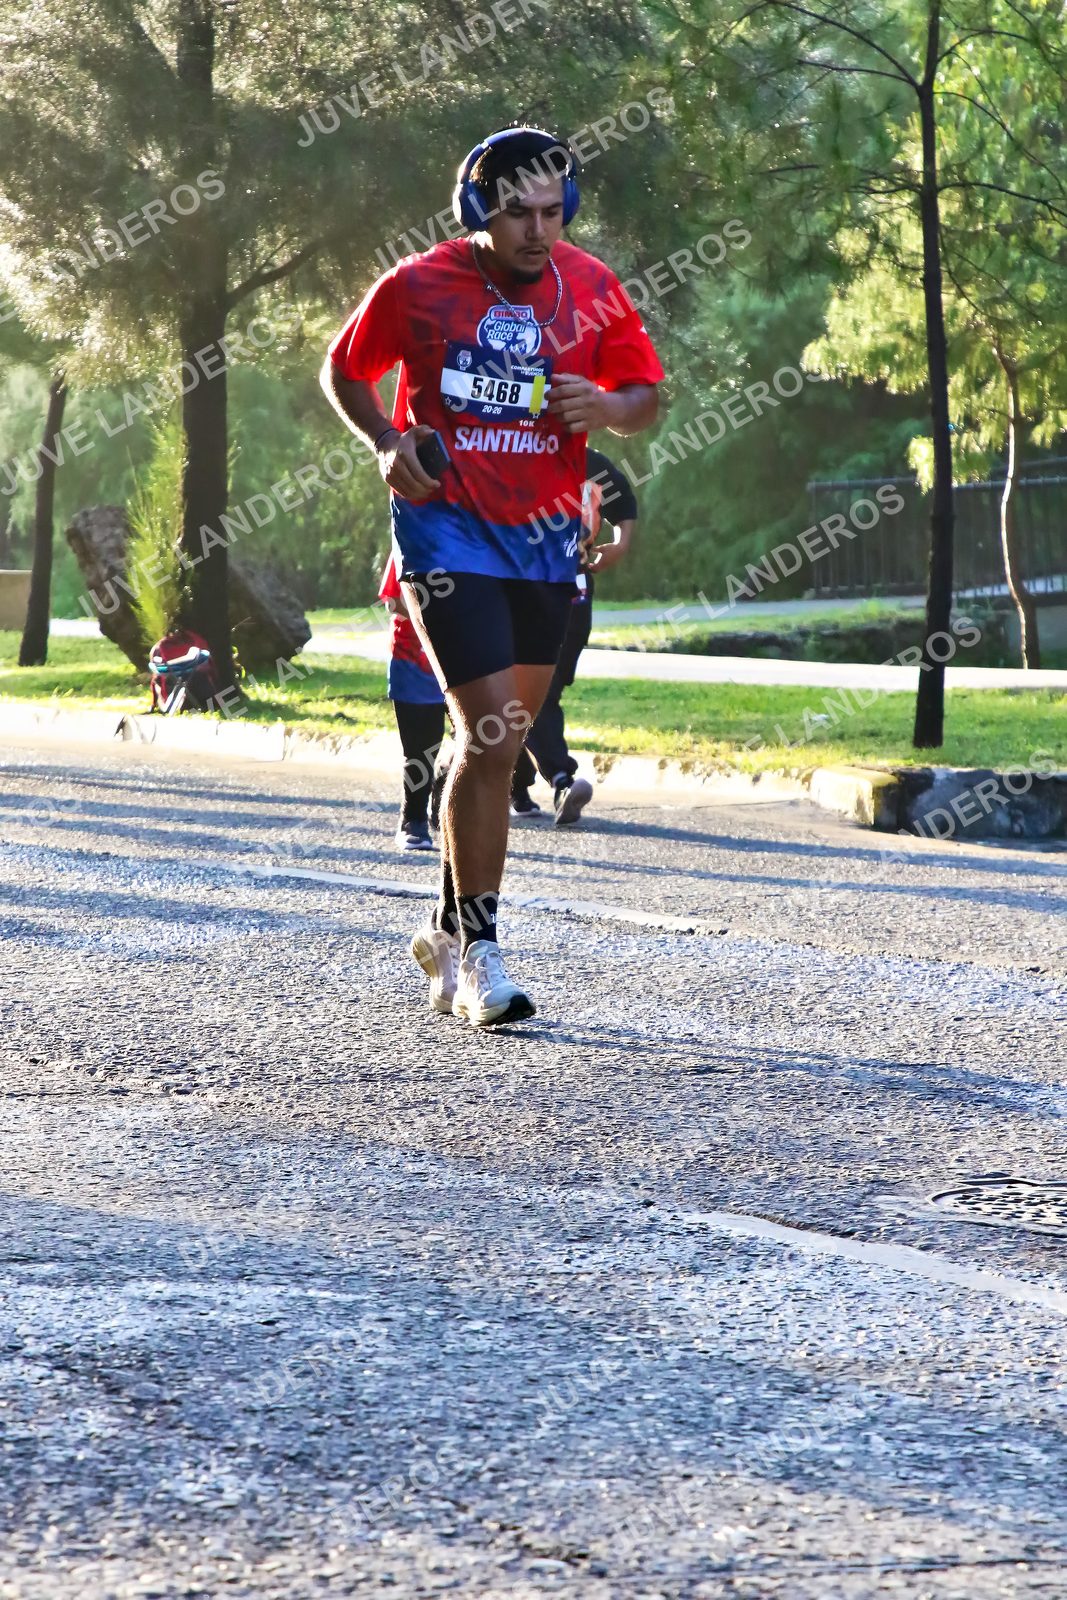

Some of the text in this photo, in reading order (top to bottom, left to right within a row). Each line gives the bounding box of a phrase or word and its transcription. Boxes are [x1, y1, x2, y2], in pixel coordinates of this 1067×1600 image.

[486, 329, 513, 340] Race
[494, 321, 526, 333] Global
[470, 377, 521, 404] 5468
[454, 426, 559, 454] SANTIAGO
